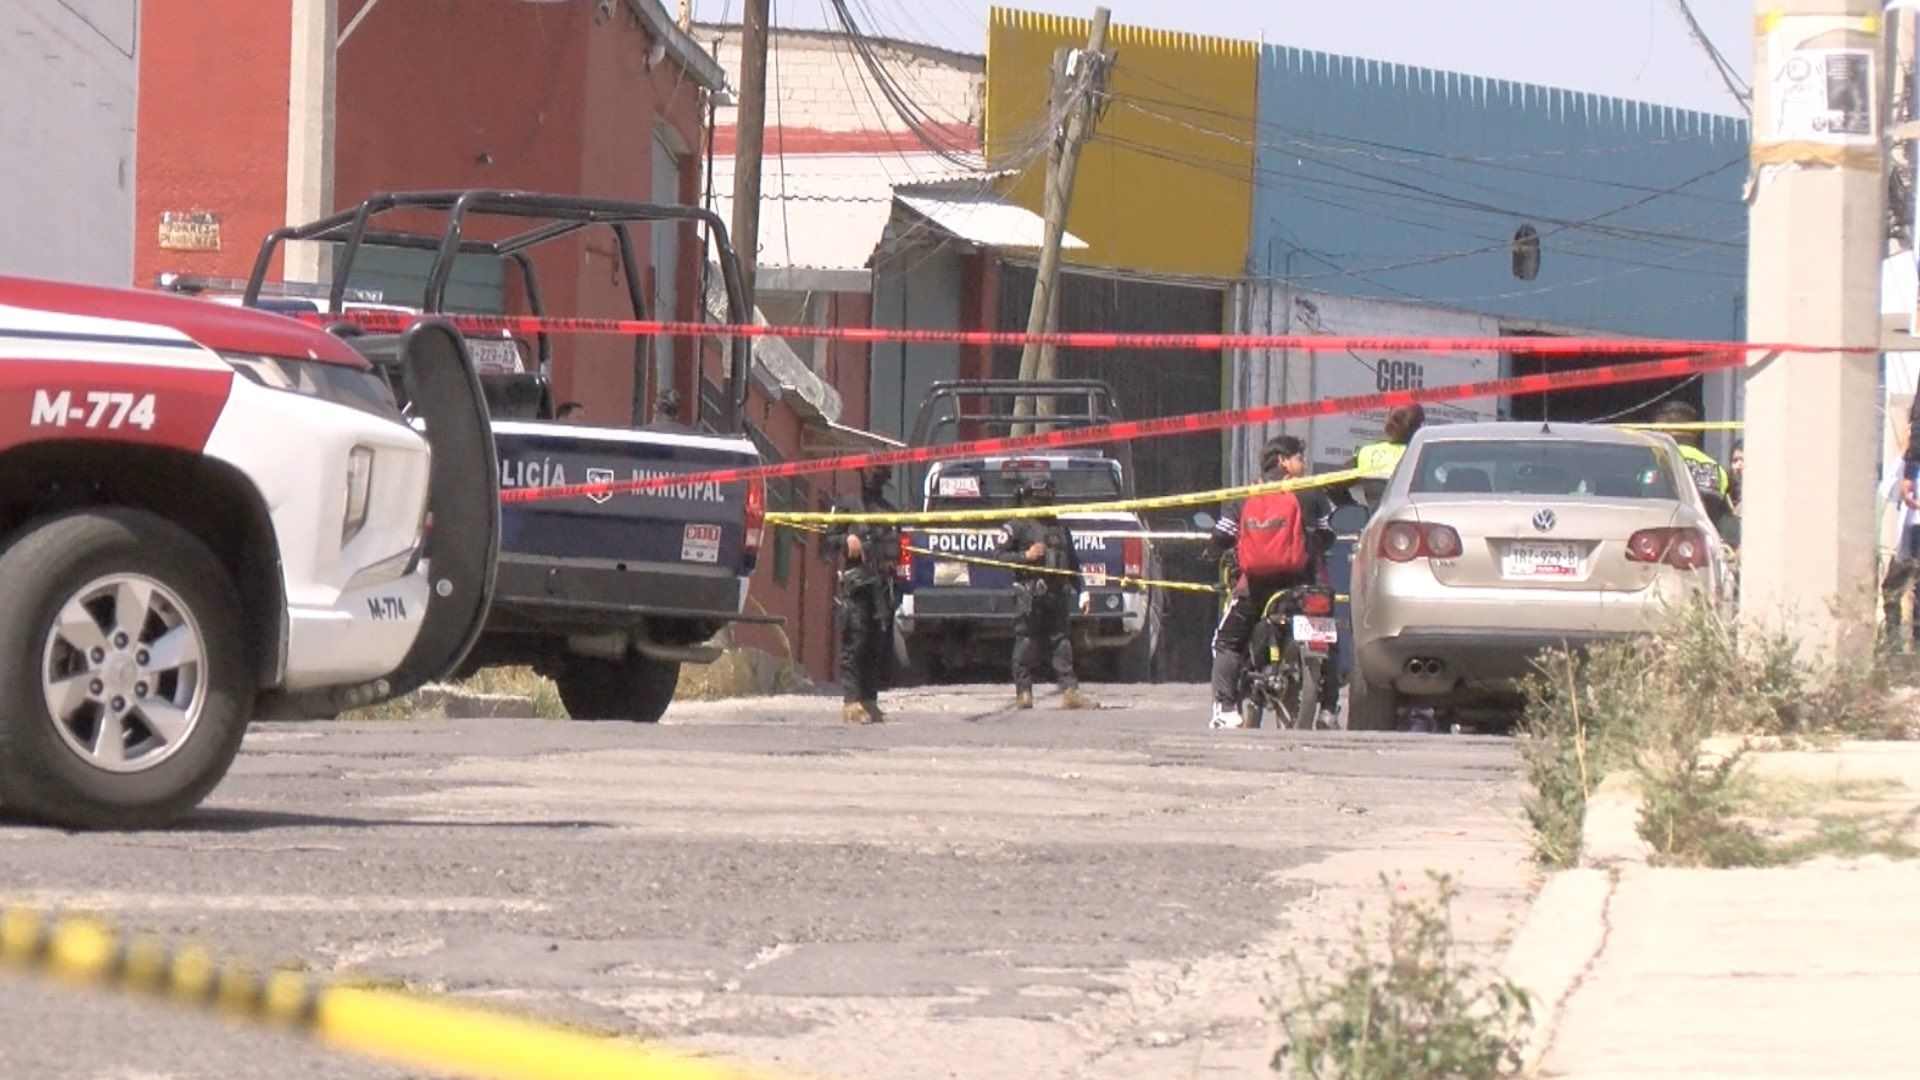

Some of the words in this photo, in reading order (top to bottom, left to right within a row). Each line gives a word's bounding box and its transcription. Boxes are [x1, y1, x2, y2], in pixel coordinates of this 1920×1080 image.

[30, 389, 156, 431] M-774
[631, 468, 725, 502] MUNICIPAL
[1513, 548, 1576, 566] TRZ-929-B
[366, 596, 407, 620] M-774
